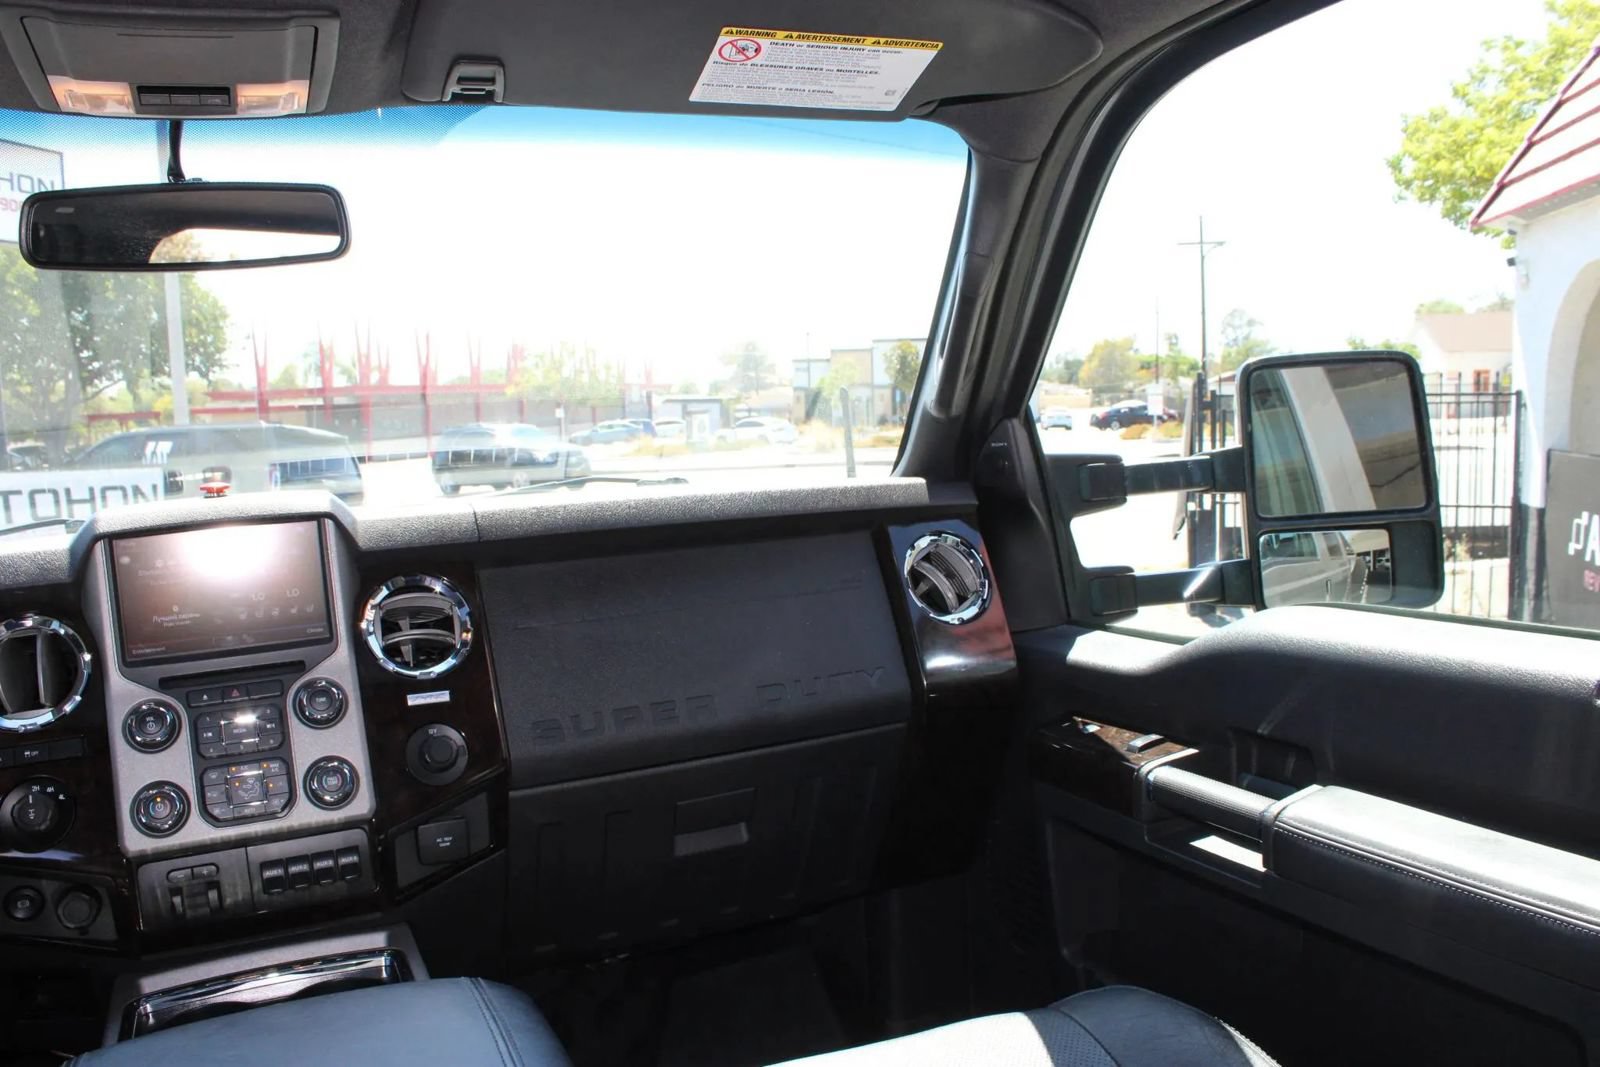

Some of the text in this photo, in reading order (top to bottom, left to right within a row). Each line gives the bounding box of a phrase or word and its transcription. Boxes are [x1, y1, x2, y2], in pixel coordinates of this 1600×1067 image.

[735, 29, 777, 38] WARNING
[795, 33, 867, 44] AVERTISSEMENT
[882, 40, 940, 49] ADVERTENCIA
[530, 666, 886, 745] SUPER DUTY
